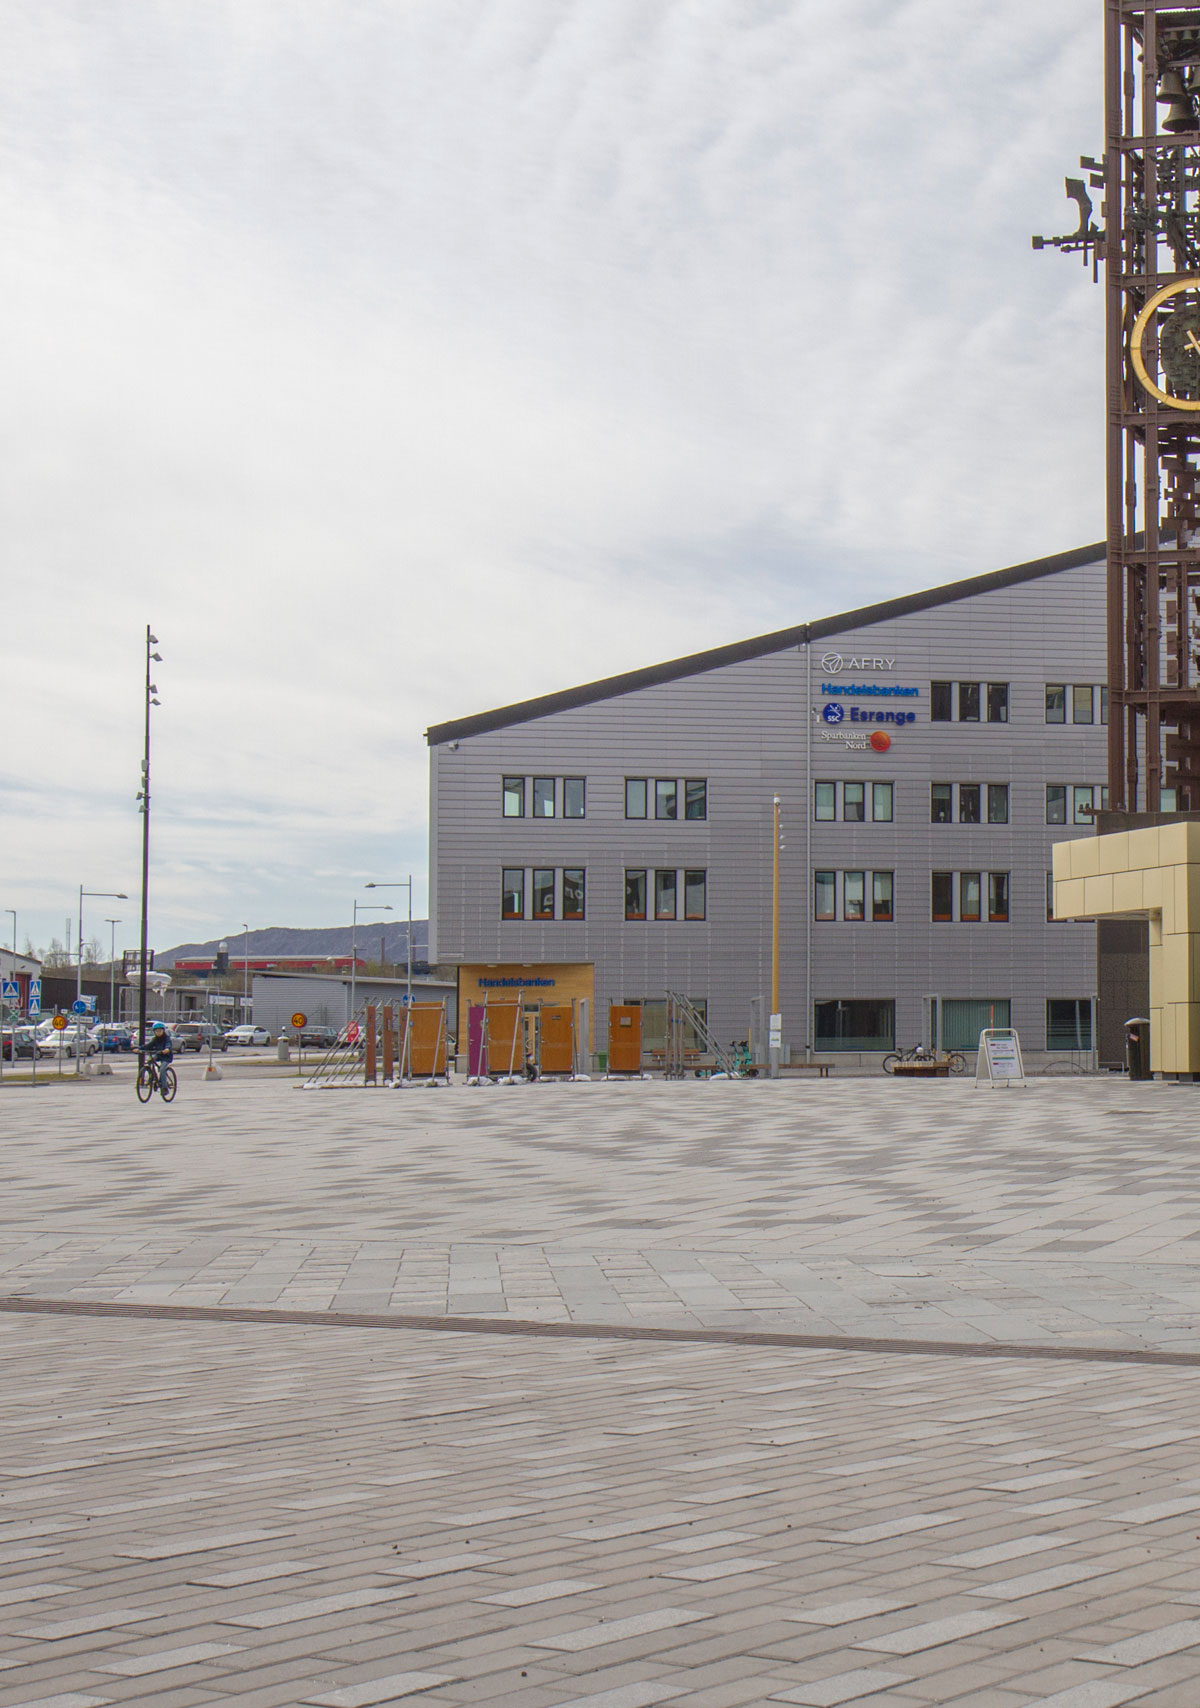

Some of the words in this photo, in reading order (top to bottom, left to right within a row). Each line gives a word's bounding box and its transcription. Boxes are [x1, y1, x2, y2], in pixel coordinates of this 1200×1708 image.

[848, 658, 895, 670] AFRY
[821, 683, 919, 696] Handelsbanken
[850, 707, 916, 726] Esrange
[821, 731, 867, 741] Sparbanken
[845, 741, 867, 750] Nord
[54, 1019, 64, 1027] 40
